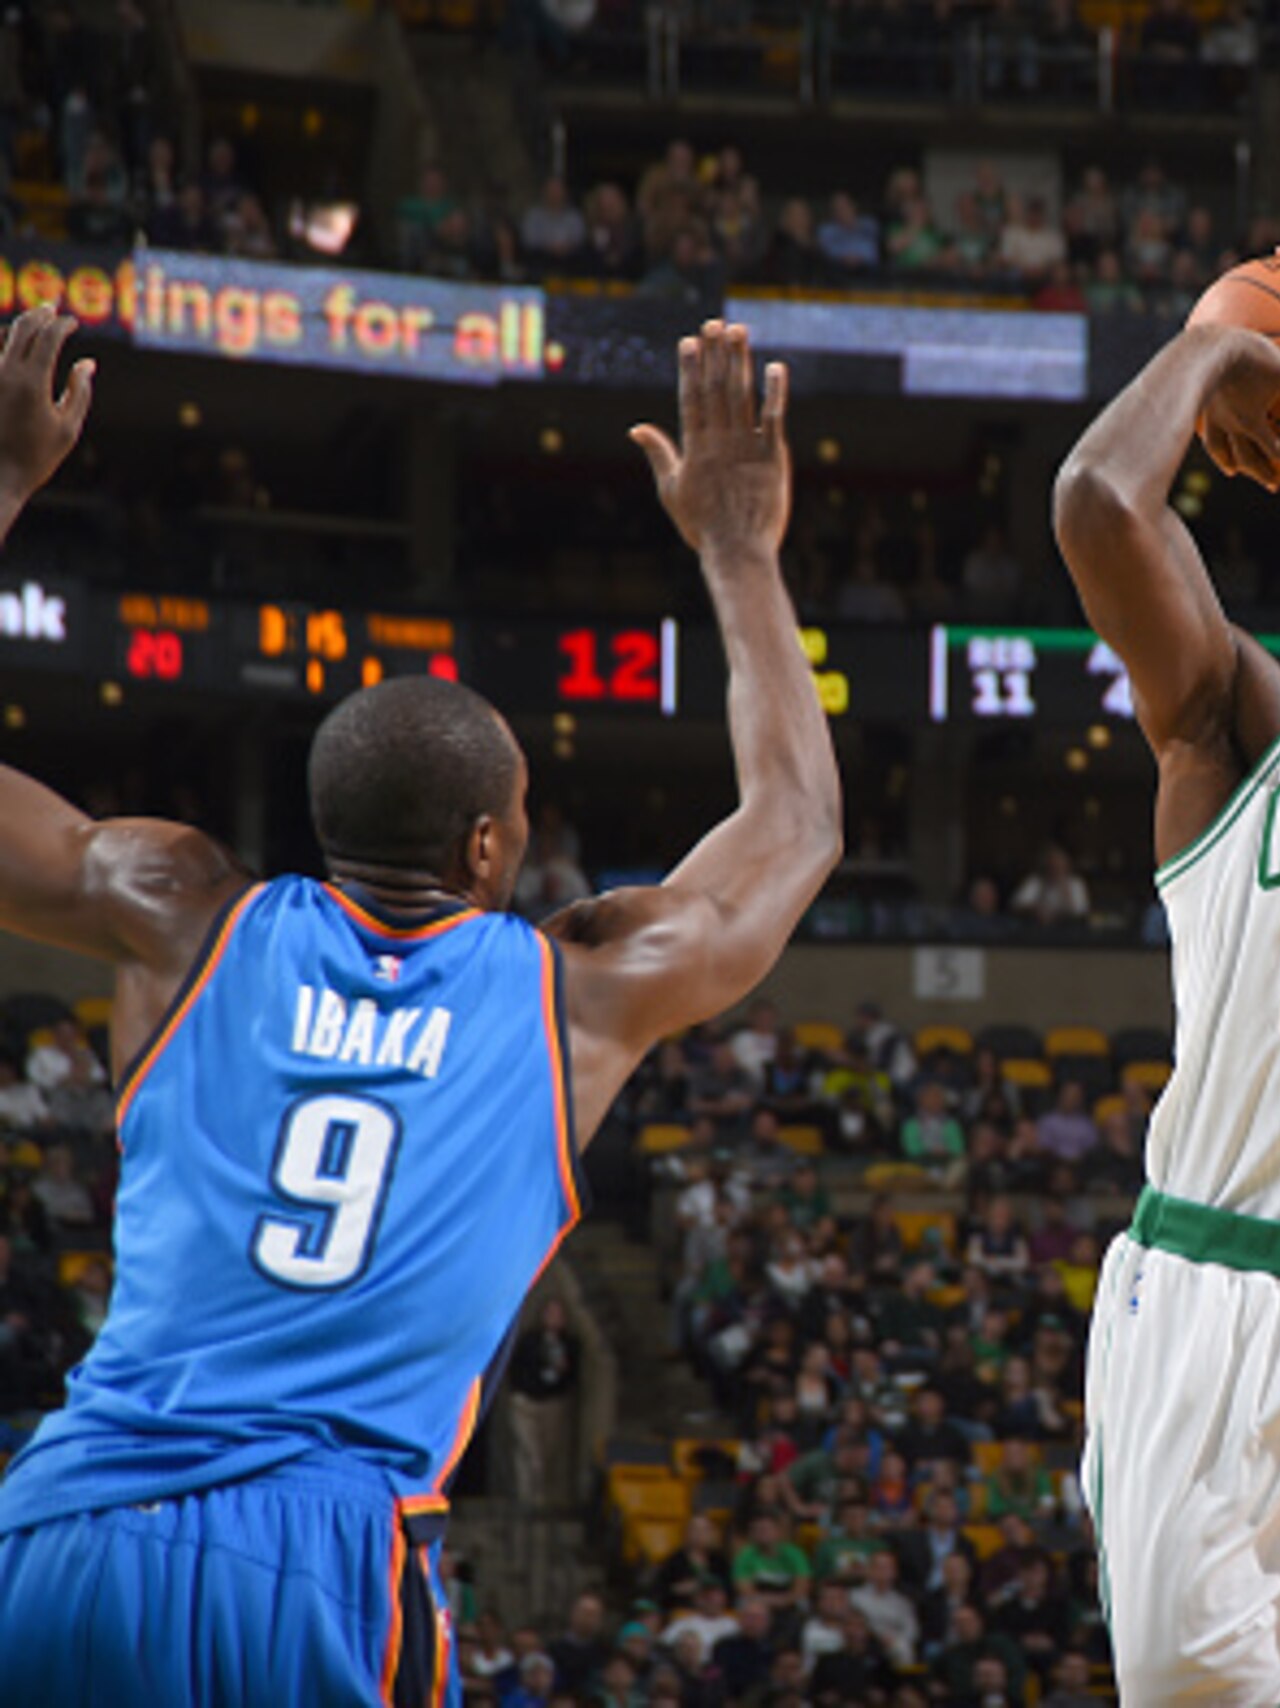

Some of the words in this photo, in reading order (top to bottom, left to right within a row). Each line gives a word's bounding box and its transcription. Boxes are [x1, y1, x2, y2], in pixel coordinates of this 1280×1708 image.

[0, 257, 302, 356] eetings
[323, 284, 432, 358] for
[454, 301, 565, 371] all.
[560, 628, 659, 699] 12
[972, 671, 1036, 716] 11
[291, 983, 452, 1080] IBAKA
[249, 1090, 404, 1293] 9
